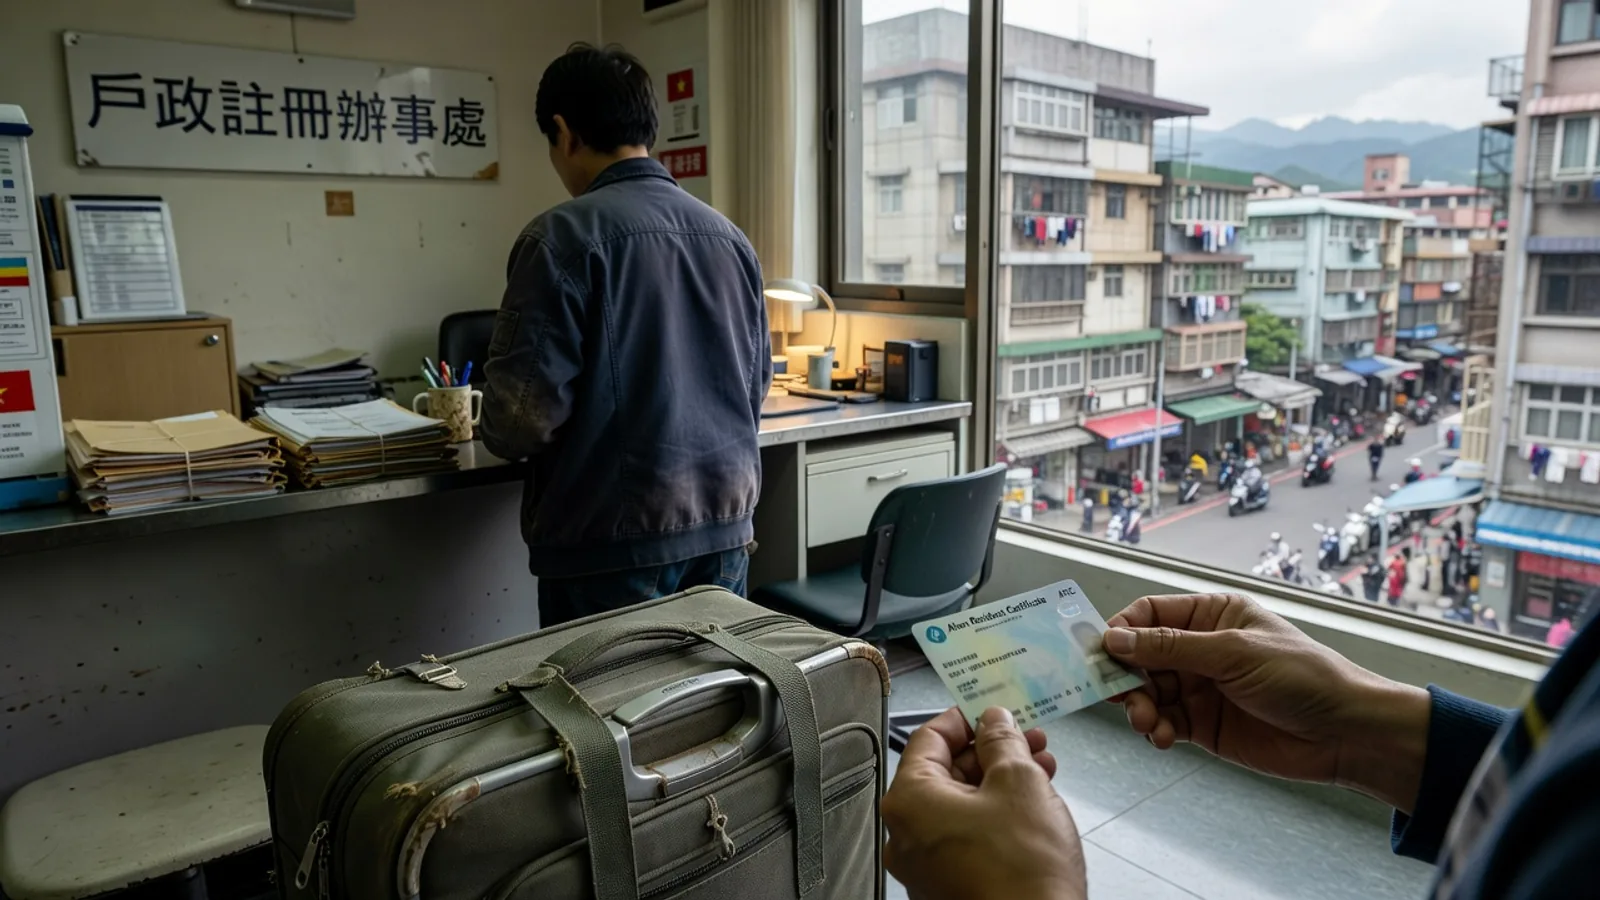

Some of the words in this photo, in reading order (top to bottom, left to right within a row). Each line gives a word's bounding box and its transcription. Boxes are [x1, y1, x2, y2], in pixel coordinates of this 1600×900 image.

[87, 72, 487, 148] 戶政註冊辦事處
